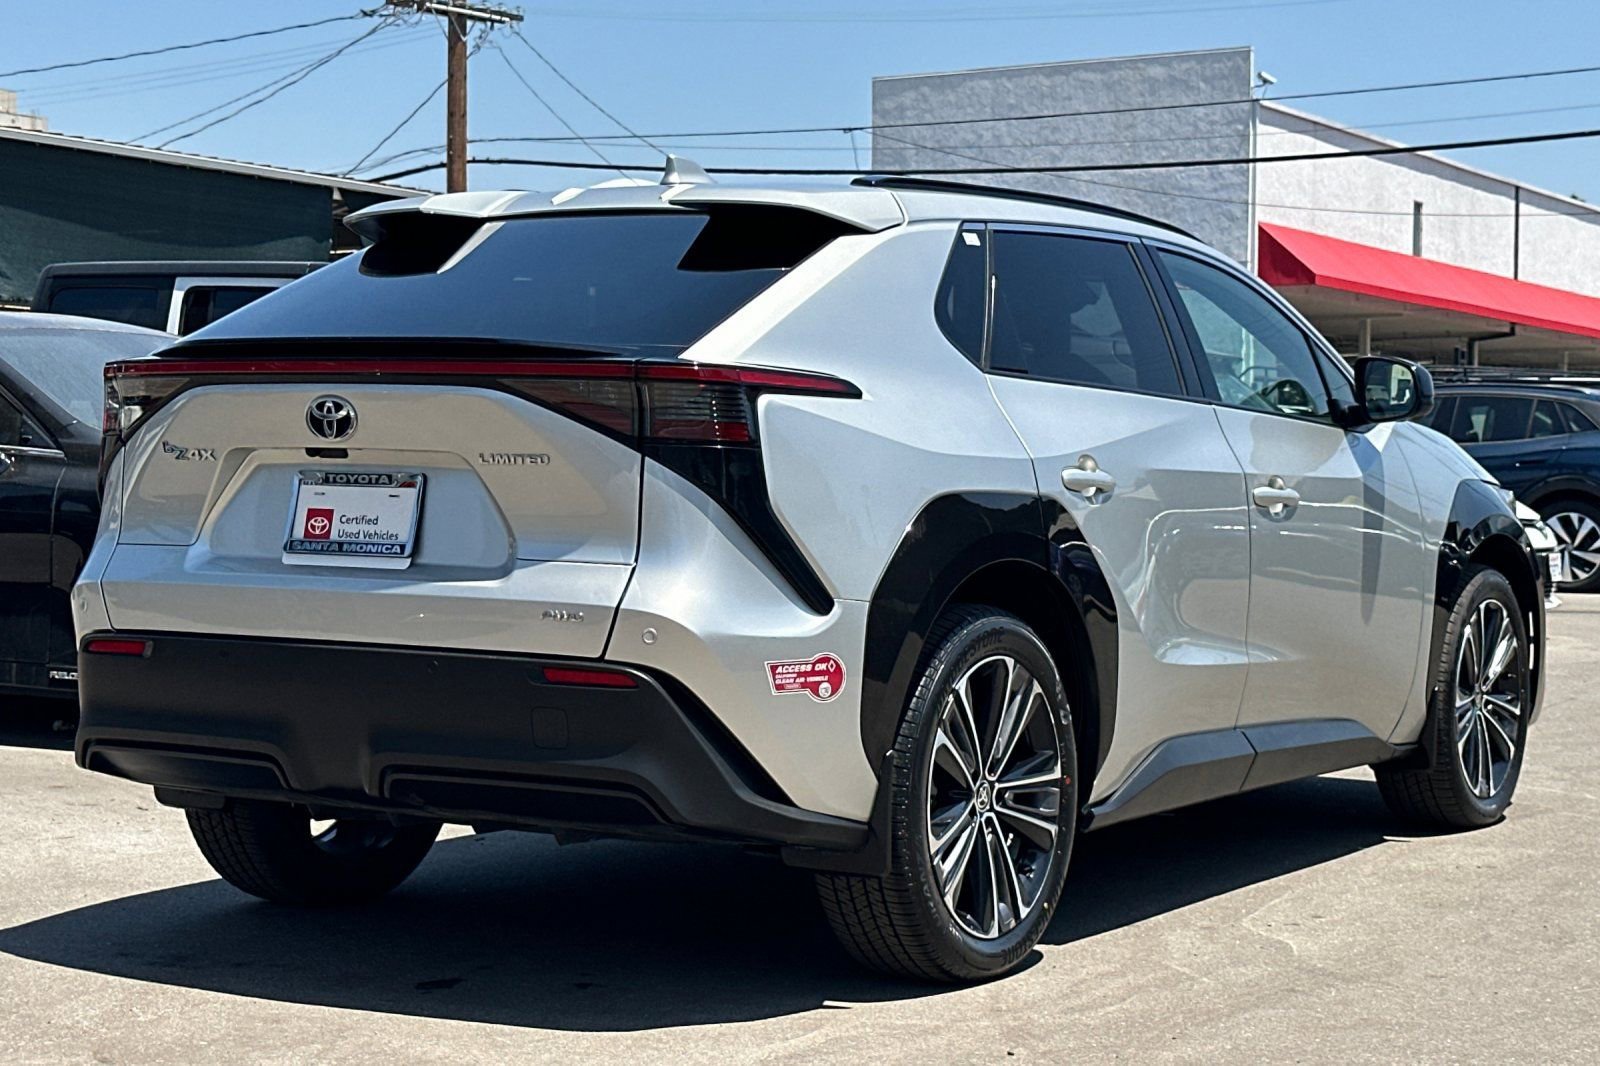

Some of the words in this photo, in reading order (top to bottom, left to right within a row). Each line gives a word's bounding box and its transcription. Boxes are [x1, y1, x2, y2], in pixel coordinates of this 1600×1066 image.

[479, 453, 551, 465] LIMITED
[326, 473, 390, 485] TOYOTA
[339, 514, 379, 525] Certified
[337, 529, 360, 539] Used
[362, 530, 399, 541] Vehicles
[291, 541, 339, 551] SANTA
[342, 543, 401, 554] MONICA
[776, 664, 813, 673] ACCESS
[814, 662, 828, 671] OK
